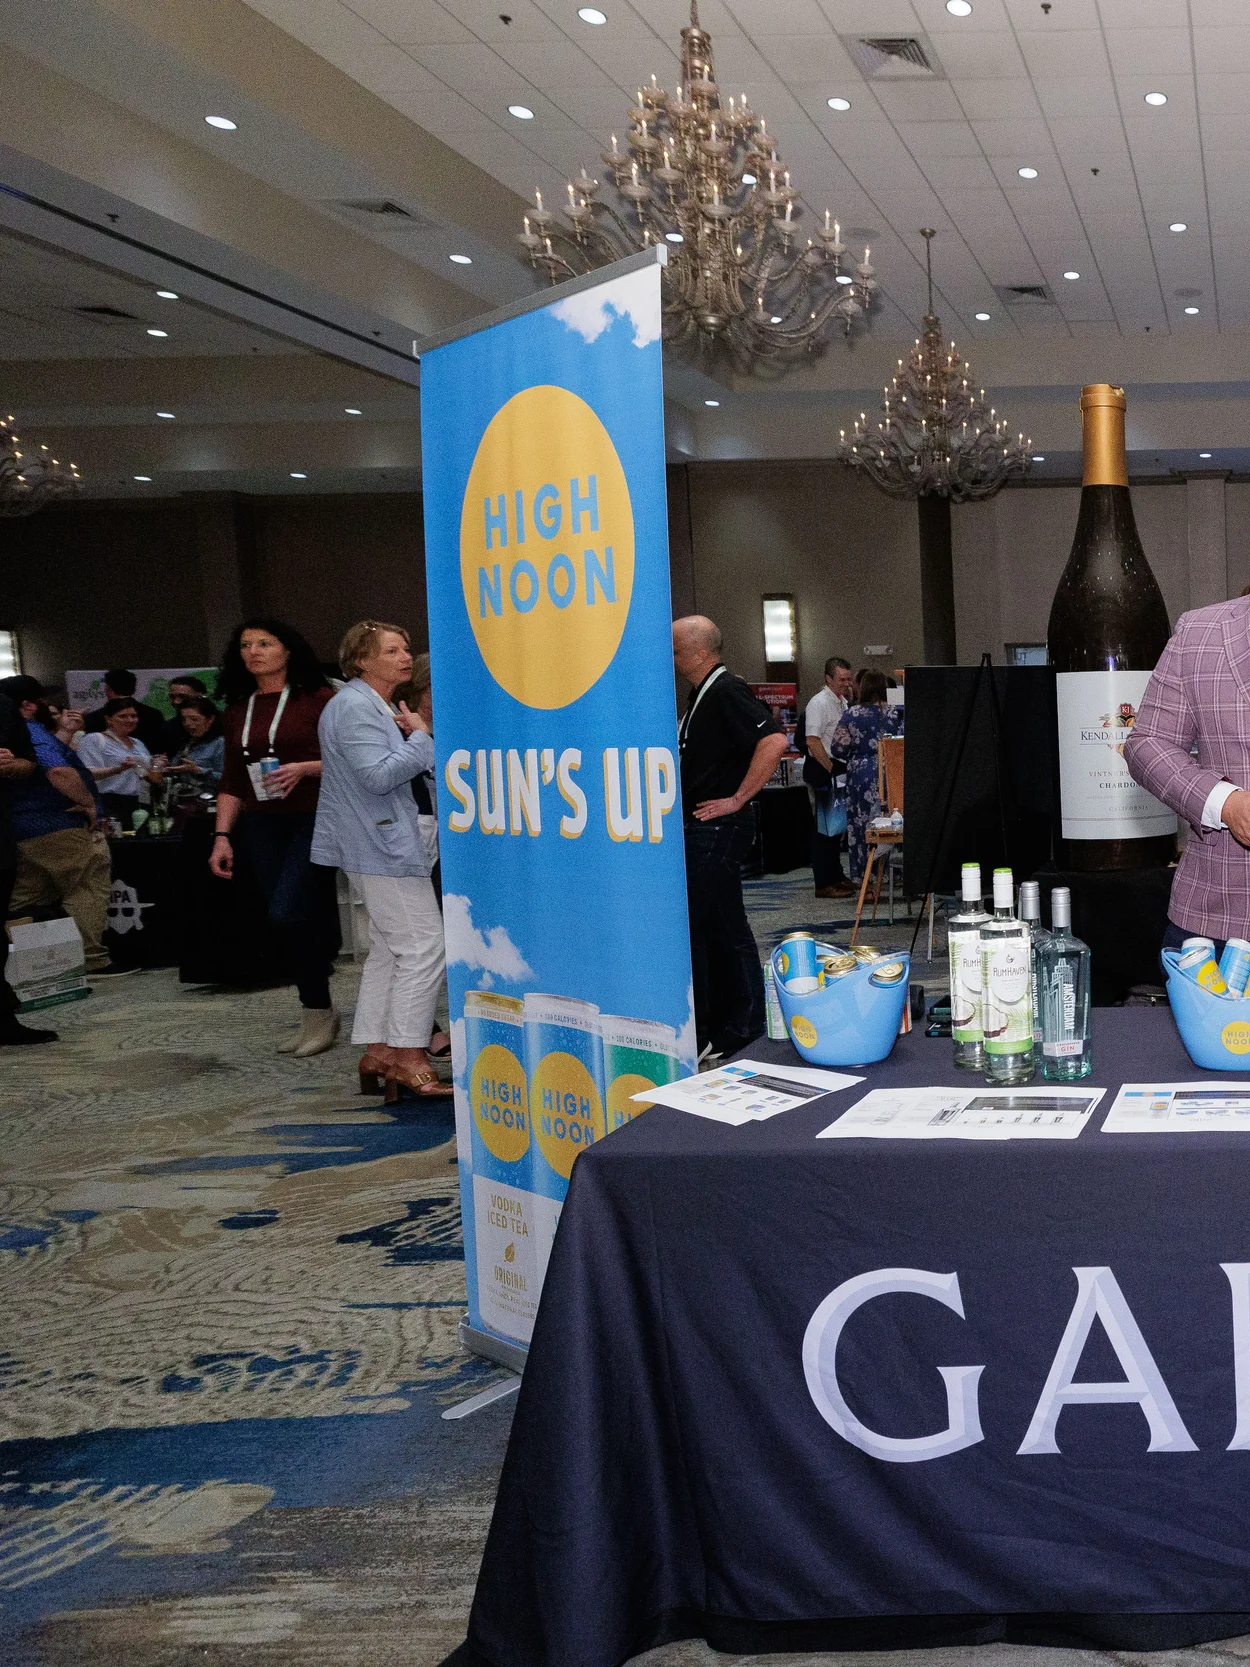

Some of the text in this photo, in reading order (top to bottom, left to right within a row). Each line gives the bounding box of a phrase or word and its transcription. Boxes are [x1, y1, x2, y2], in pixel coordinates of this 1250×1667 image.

[483, 474, 600, 550] HIGH
[477, 545, 617, 619] NOON
[445, 746, 677, 844] SUN'S UP
[1099, 781, 1140, 789] CHARDO
[554, 1013, 578, 1025] CALORIES
[1063, 983, 1076, 1030] AMSTERDAM
[626, 1036, 652, 1048] CALORIES
[1060, 1045, 1075, 1053] GIN
[480, 1077, 523, 1107] HIGH
[541, 1087, 591, 1120] HIGH
[479, 1102, 527, 1132] NOON
[540, 1114, 595, 1146] NOON
[490, 1193, 523, 1218] VODKA
[487, 1209, 508, 1231] ICED
[510, 1216, 529, 1237] TEA
[493, 1264, 528, 1292] ORIGINAL
